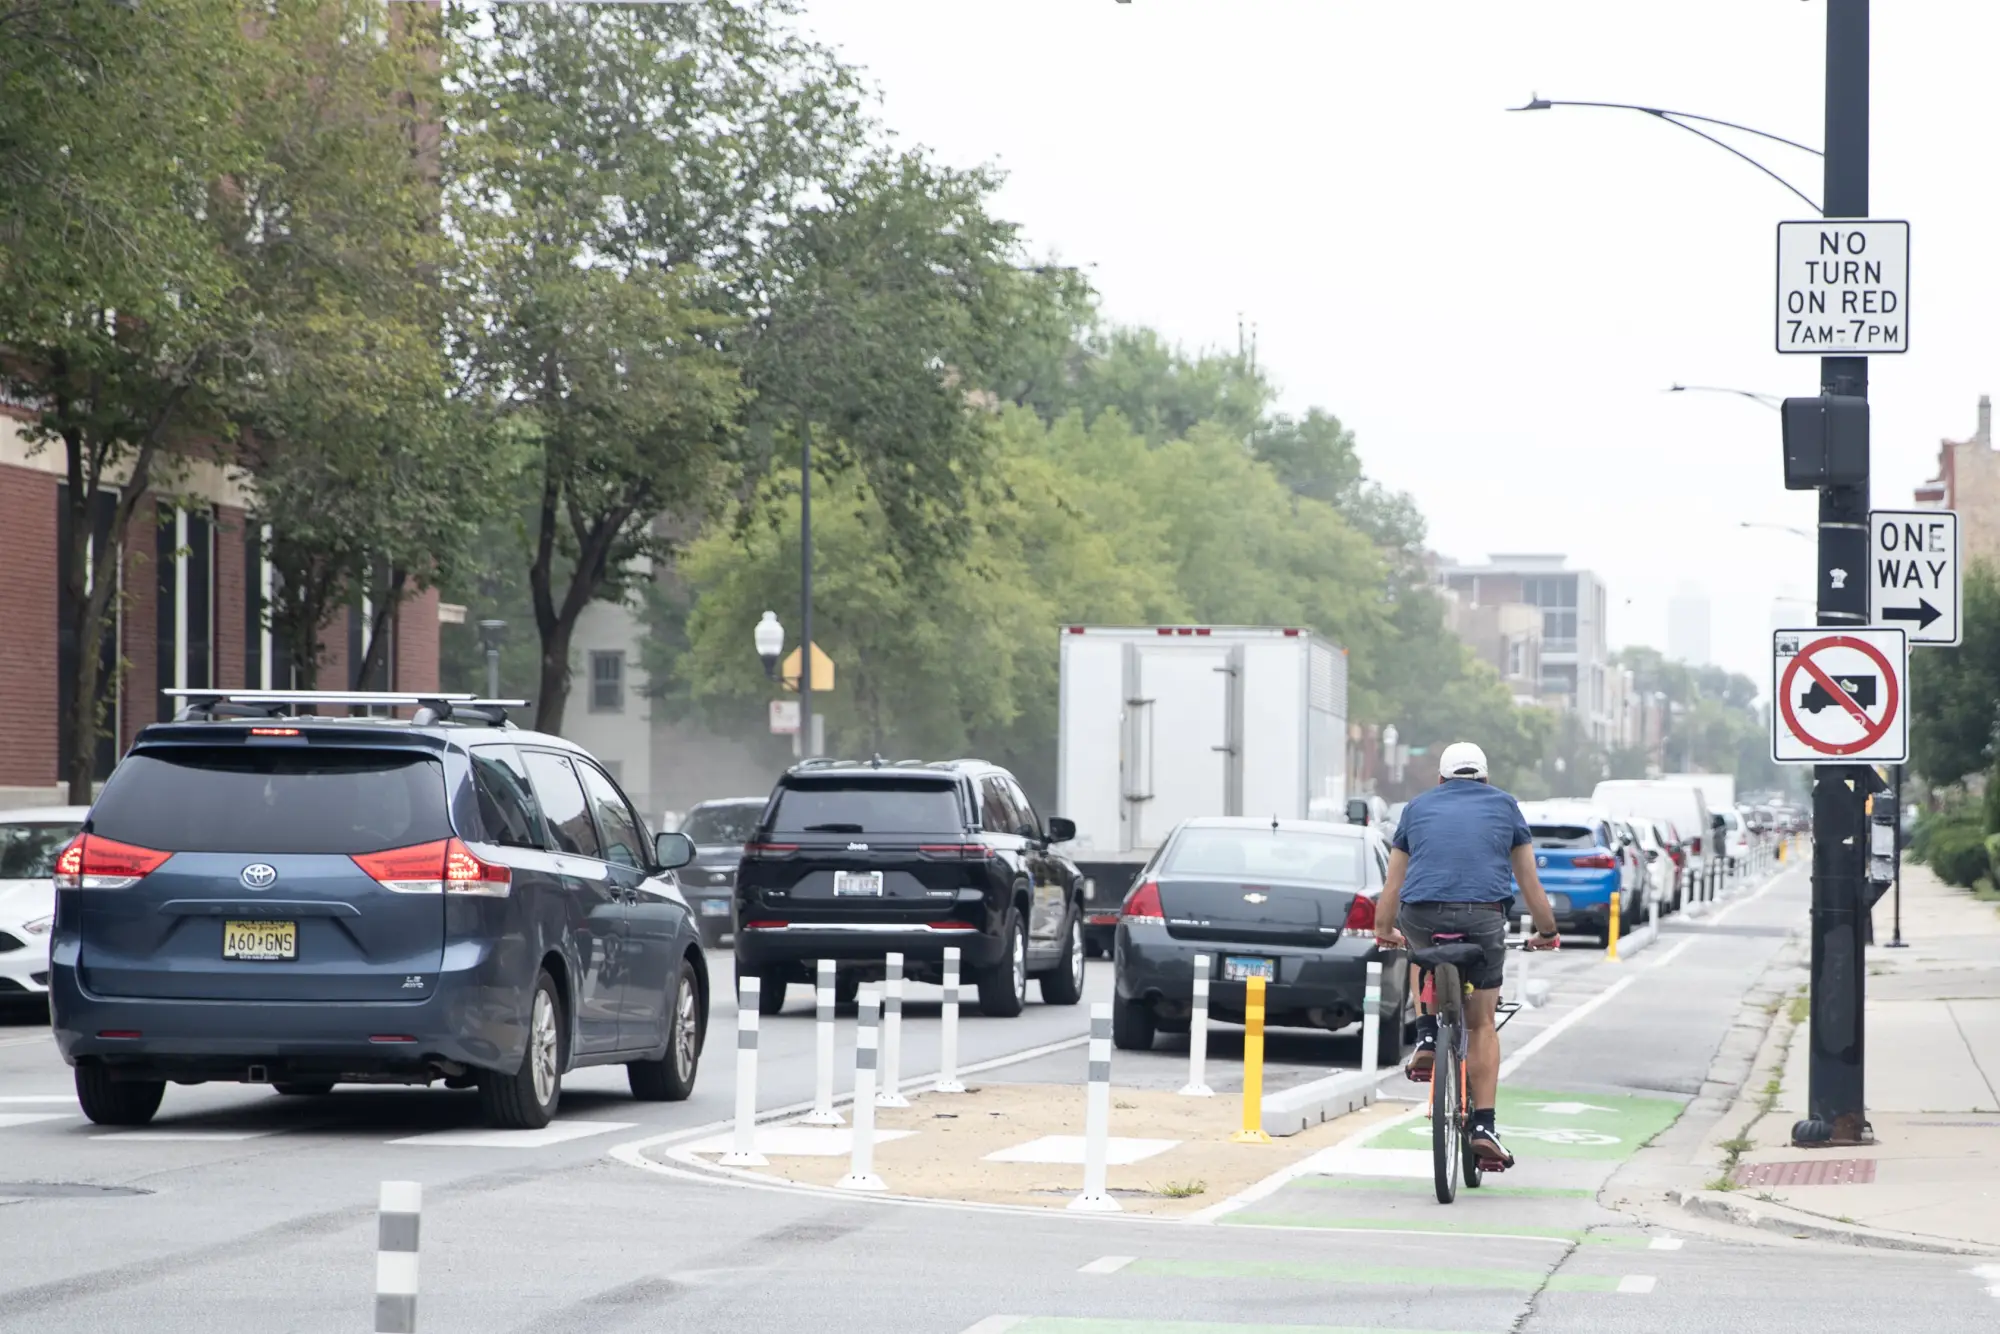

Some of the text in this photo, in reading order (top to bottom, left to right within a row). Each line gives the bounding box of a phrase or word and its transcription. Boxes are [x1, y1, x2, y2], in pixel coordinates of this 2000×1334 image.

[1820, 231, 1866, 255] NO
[1805, 261, 1881, 284] TURN
[1787, 290, 1897, 314] ON RED
[1786, 320, 1898, 343] 7AM-7PM
[1880, 522, 1945, 552] ONE
[1878, 559, 1947, 589] WAY
[228, 932, 293, 951] A60 GNS
